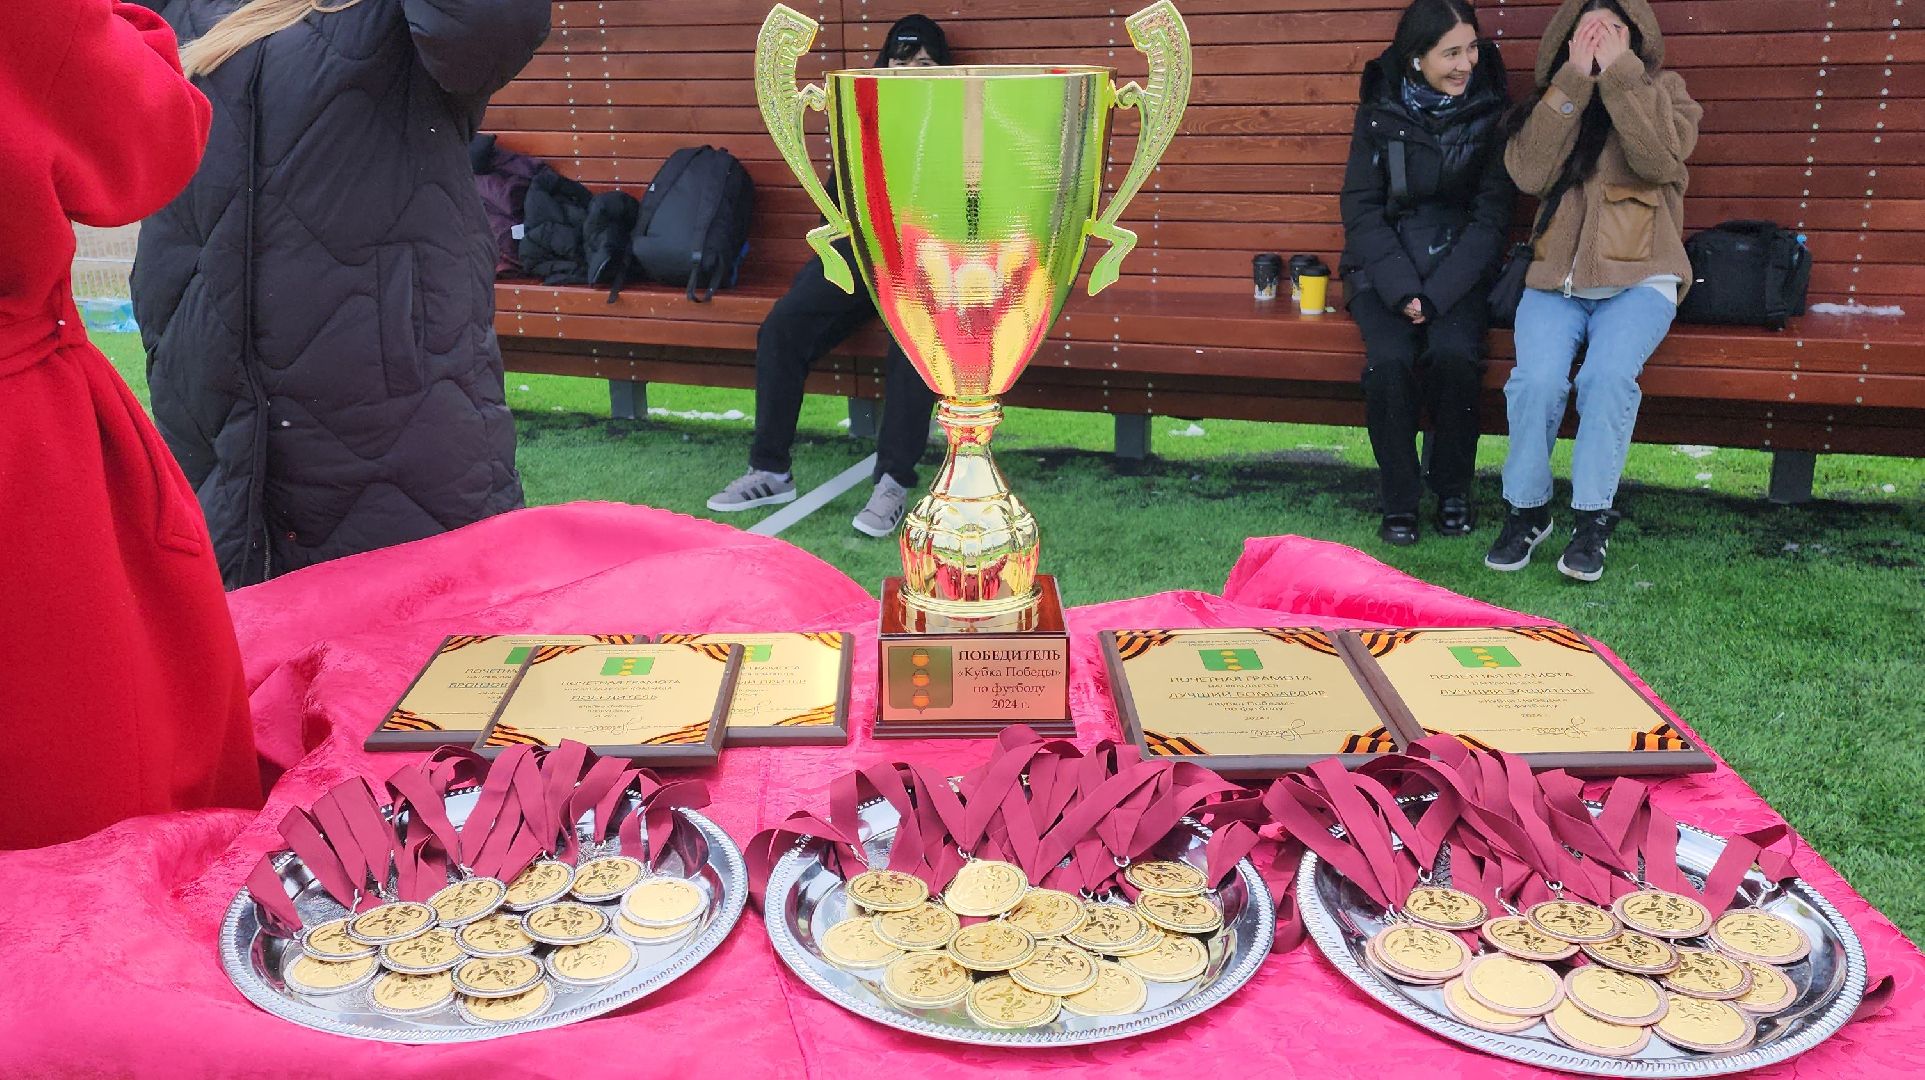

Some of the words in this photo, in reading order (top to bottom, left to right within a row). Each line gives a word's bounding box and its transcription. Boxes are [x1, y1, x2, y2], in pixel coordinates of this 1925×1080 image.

[958, 650, 1061, 661] ПОБЕДИТЕЛЬ
[958, 666, 1002, 680] «Кубка
[1005, 666, 1061, 678] Победы»
[973, 685, 988, 693] по
[991, 683, 1046, 696] футболу
[991, 699, 1018, 709] 2024
